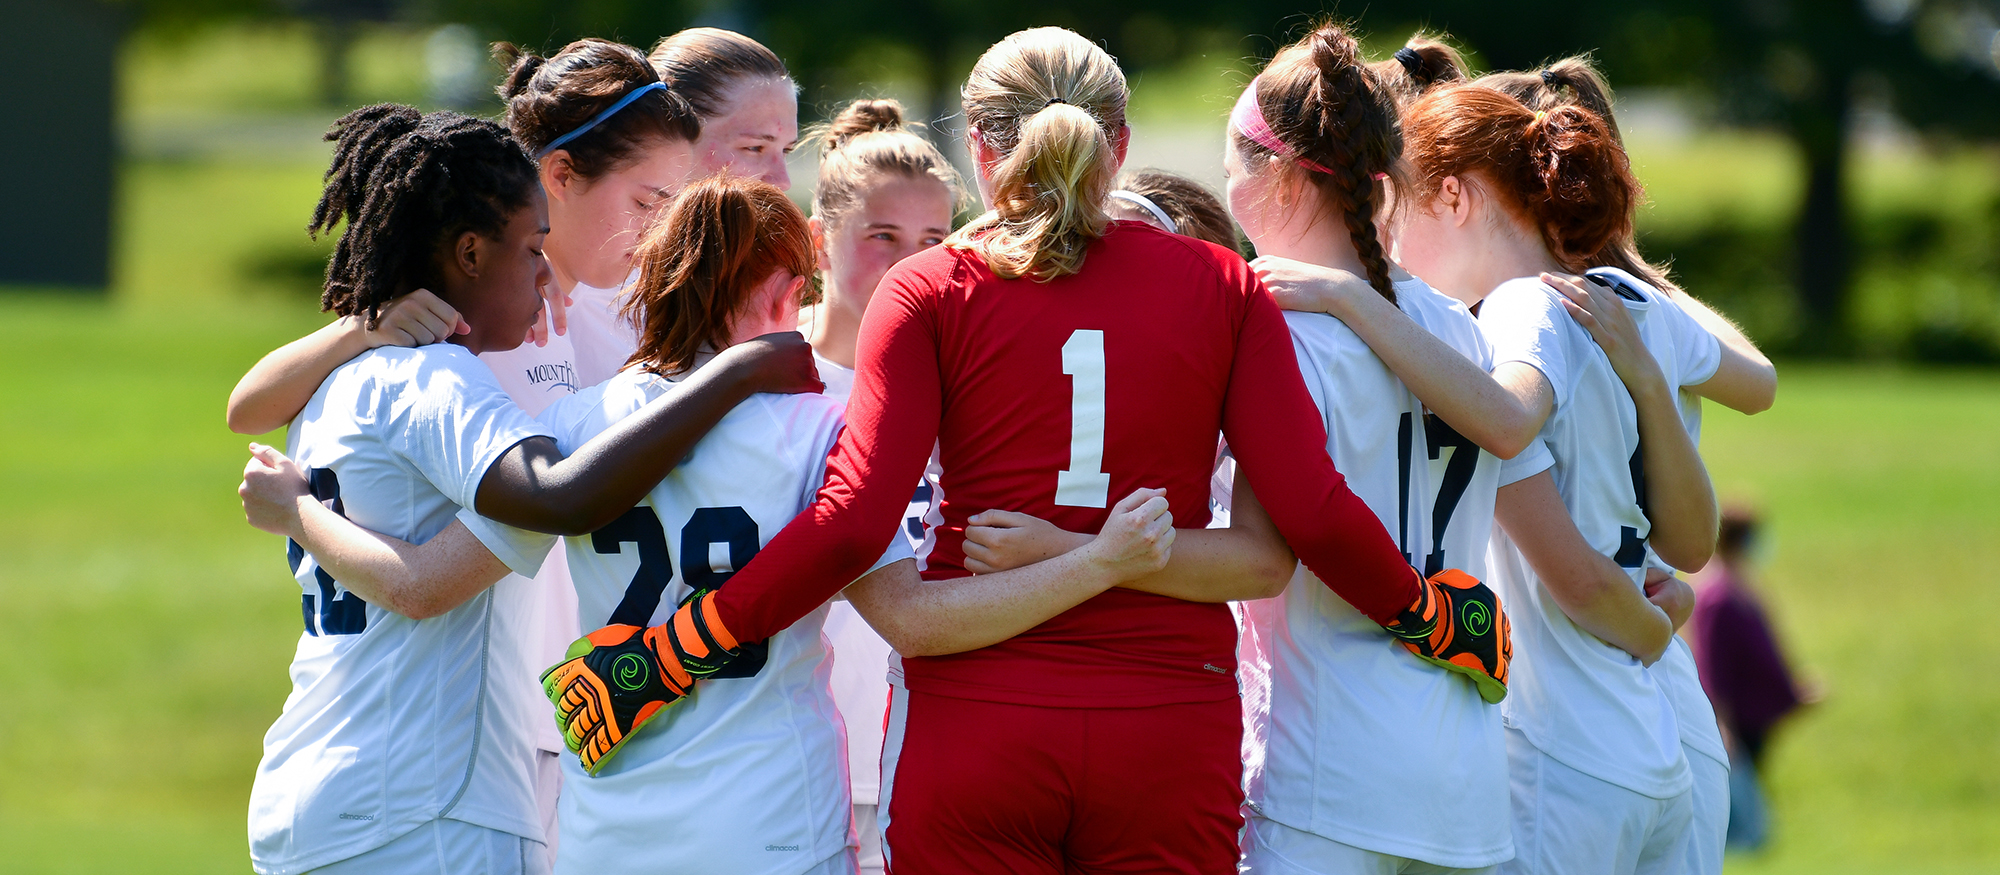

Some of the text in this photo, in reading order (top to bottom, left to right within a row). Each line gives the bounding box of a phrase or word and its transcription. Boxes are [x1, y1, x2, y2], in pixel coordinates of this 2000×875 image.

[1054, 329, 1111, 509] 1
[1398, 411, 1480, 580] 17
[339, 812, 375, 821] climacool
[765, 844, 799, 852] climacool
